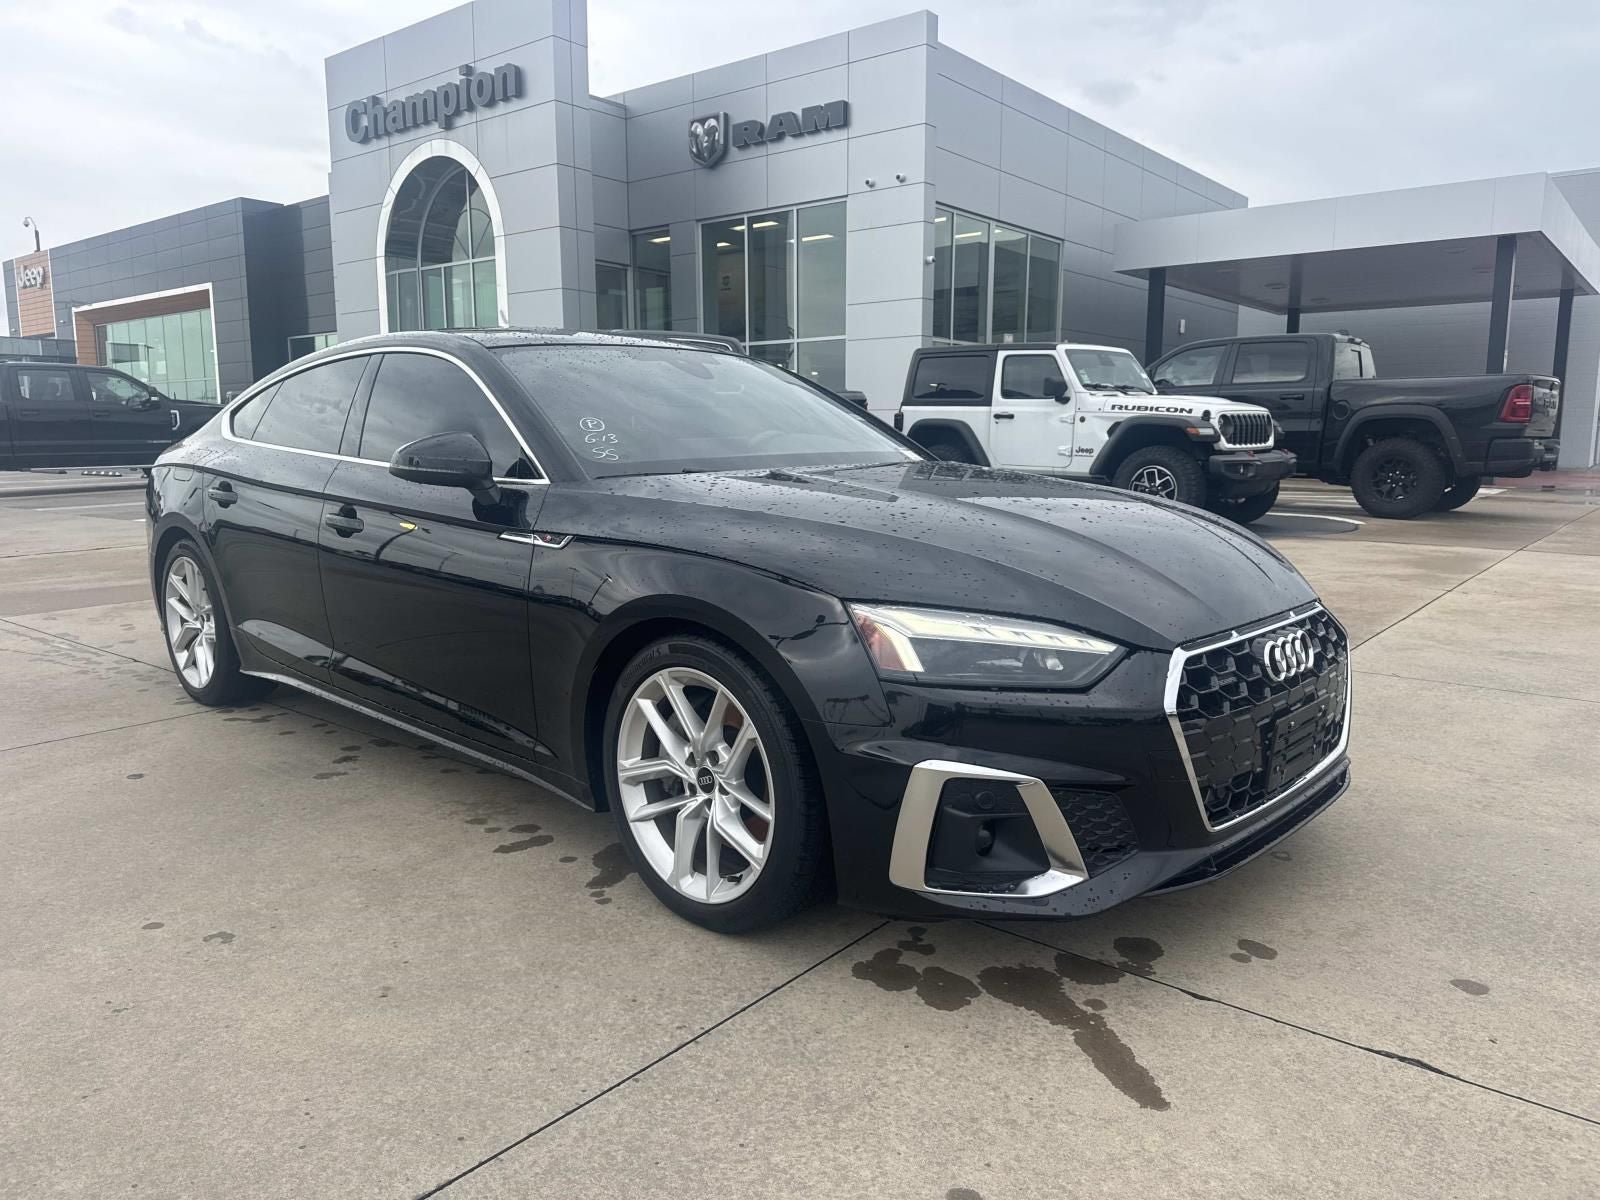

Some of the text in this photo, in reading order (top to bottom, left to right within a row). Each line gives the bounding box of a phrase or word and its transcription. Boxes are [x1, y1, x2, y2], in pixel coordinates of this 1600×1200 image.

[345, 63, 521, 144] Champion
[732, 100, 849, 148] RAM
[18, 264, 44, 289] Jeep
[1111, 403, 1193, 415] RUBICON
[1075, 446, 1094, 454] Jeep
